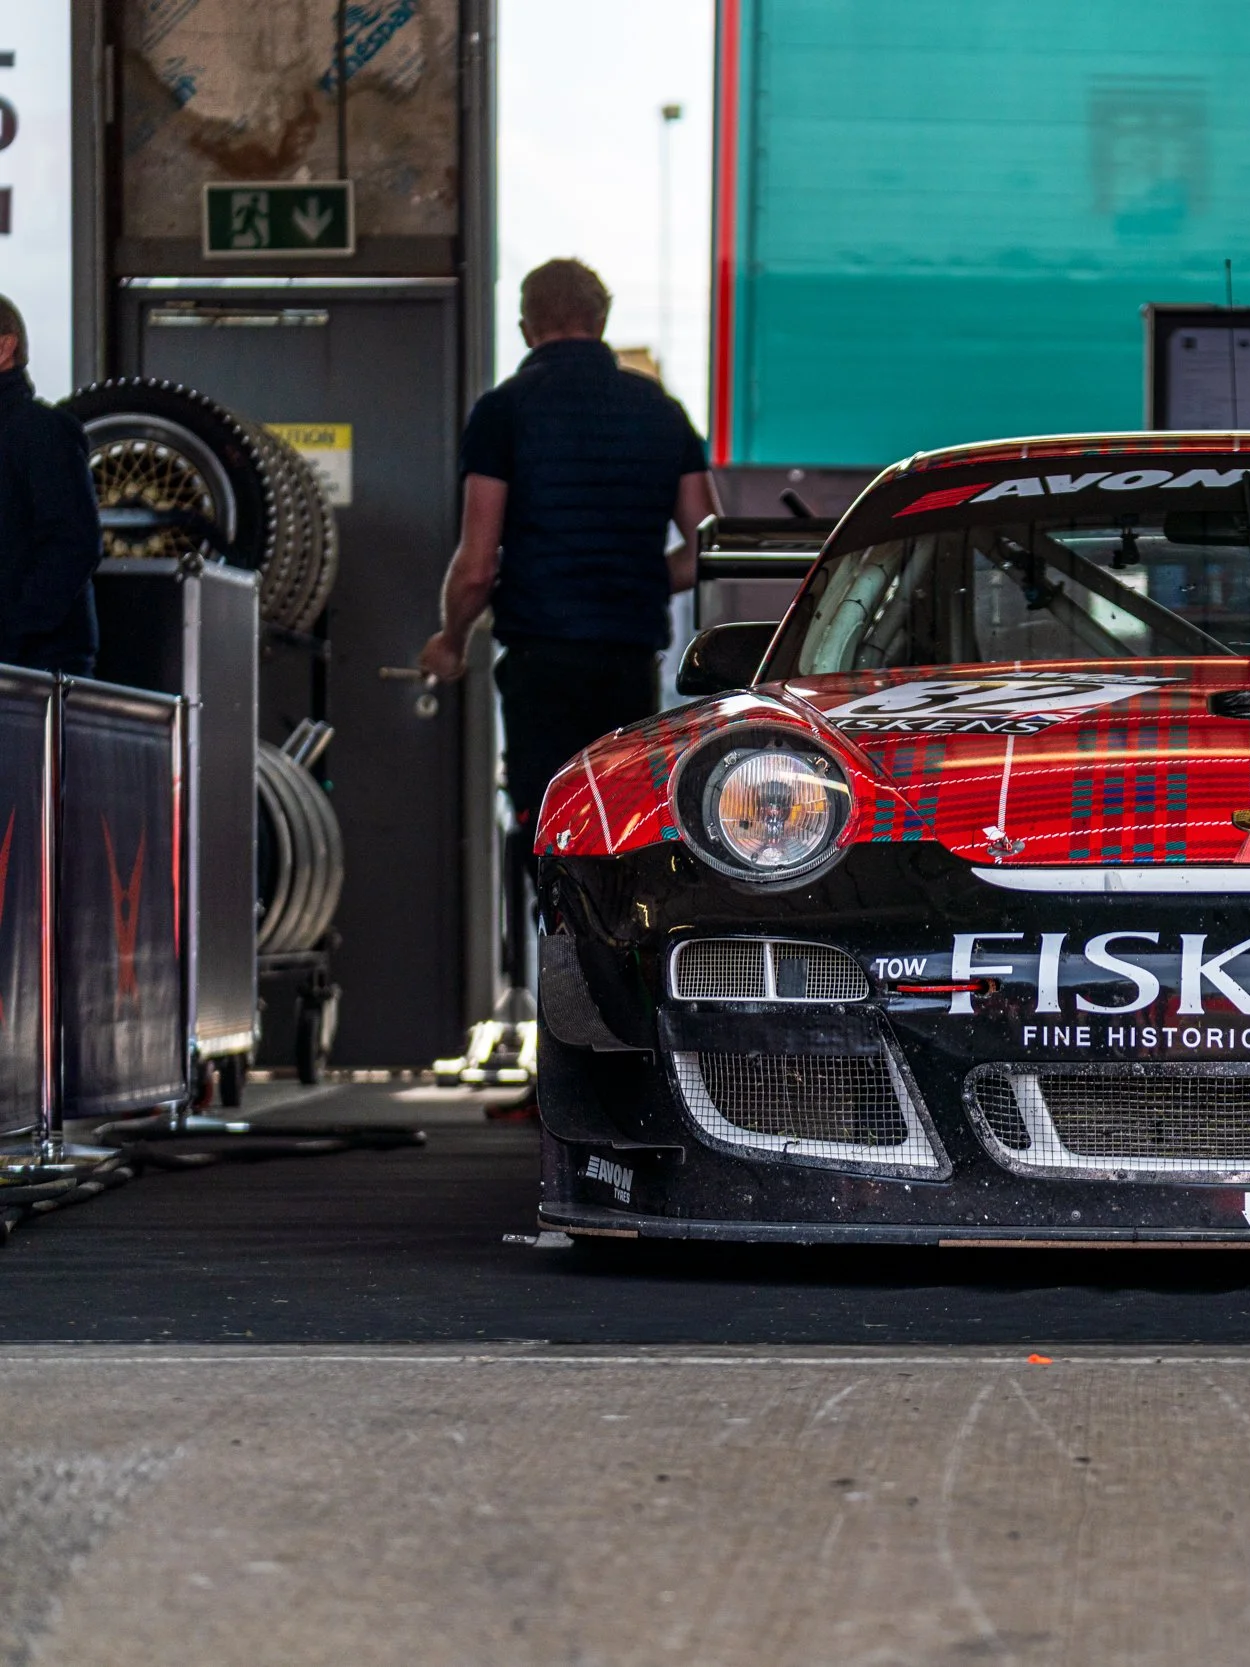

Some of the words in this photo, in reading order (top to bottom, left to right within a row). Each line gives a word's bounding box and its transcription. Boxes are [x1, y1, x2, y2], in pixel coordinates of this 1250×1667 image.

[849, 680, 1105, 714] 32
[836, 718, 1050, 733] ISKENS
[875, 957, 927, 979] TOW
[1023, 1025, 1091, 1047] FINE
[598, 1158, 634, 1192] AVON
[613, 1186, 631, 1204] TYRES
